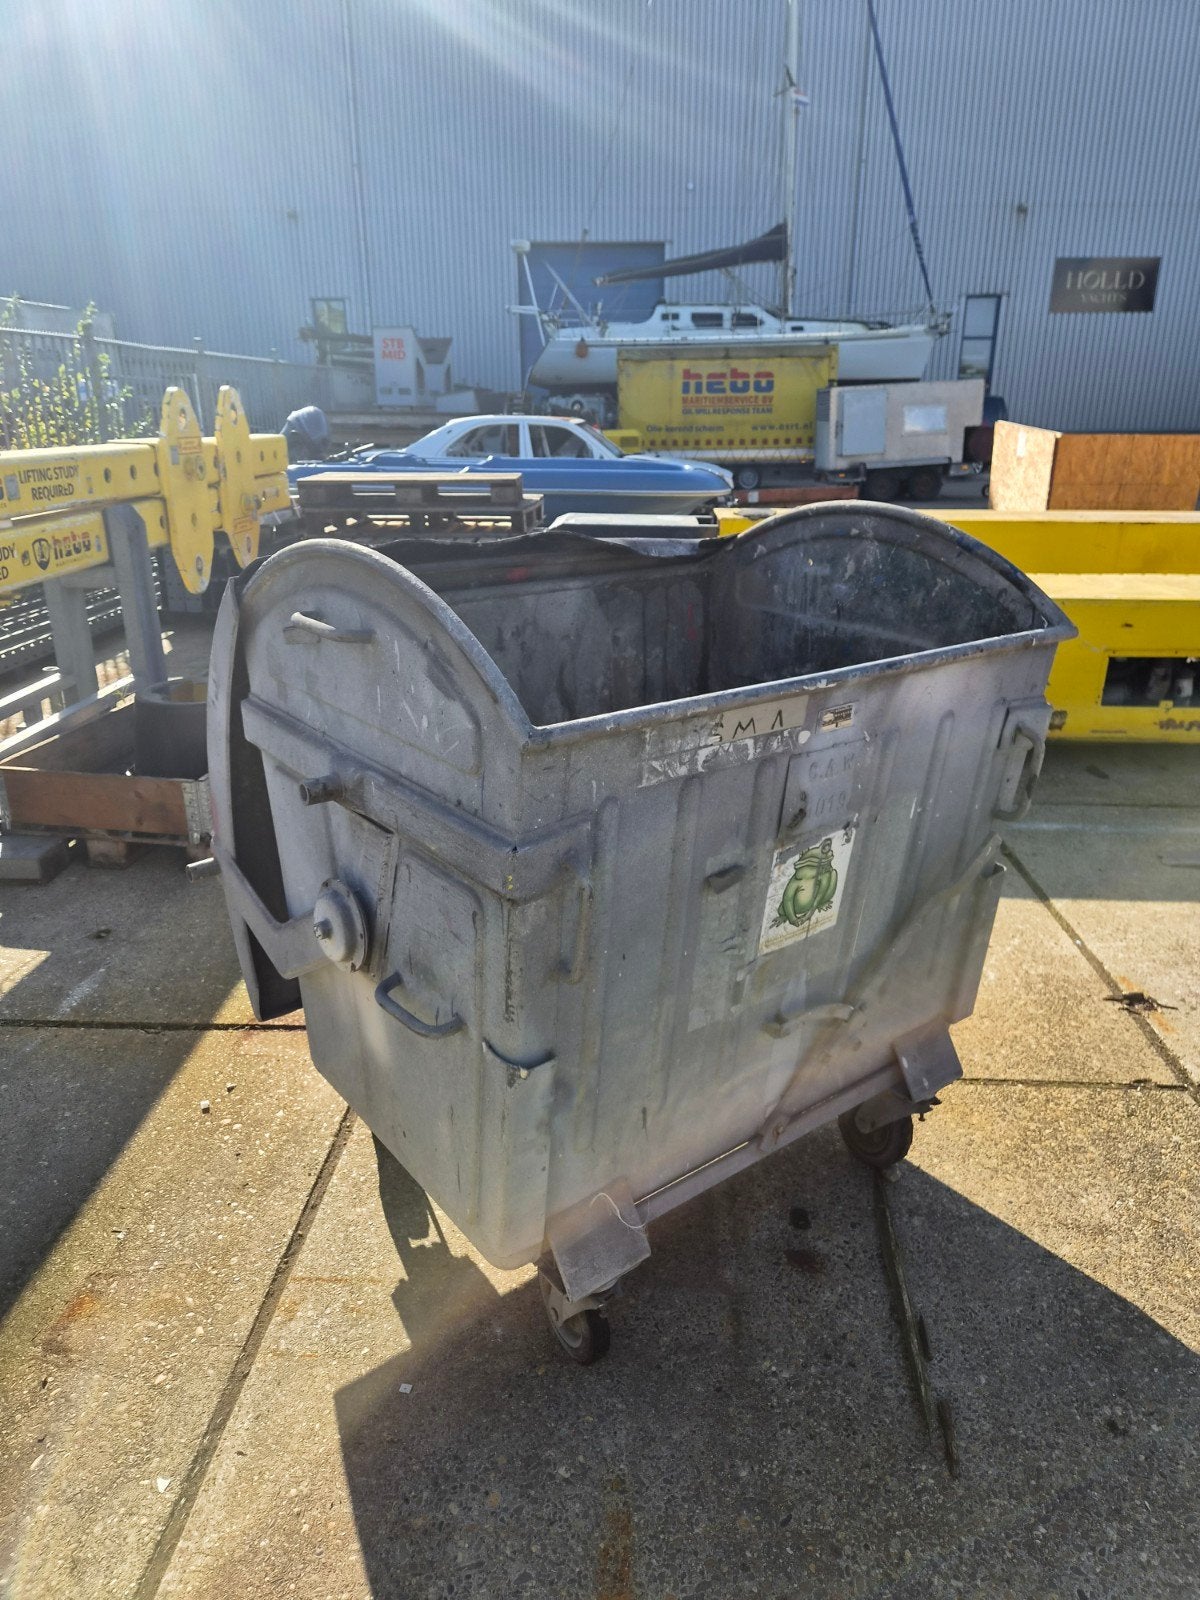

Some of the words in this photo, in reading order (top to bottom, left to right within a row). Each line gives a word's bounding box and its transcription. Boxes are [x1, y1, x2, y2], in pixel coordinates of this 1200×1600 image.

[752, 406, 773, 414] TEAM
[18, 467, 53, 484] LIFTING
[53, 465, 80, 480] STUDY
[31, 483, 75, 501] REQUIRED
